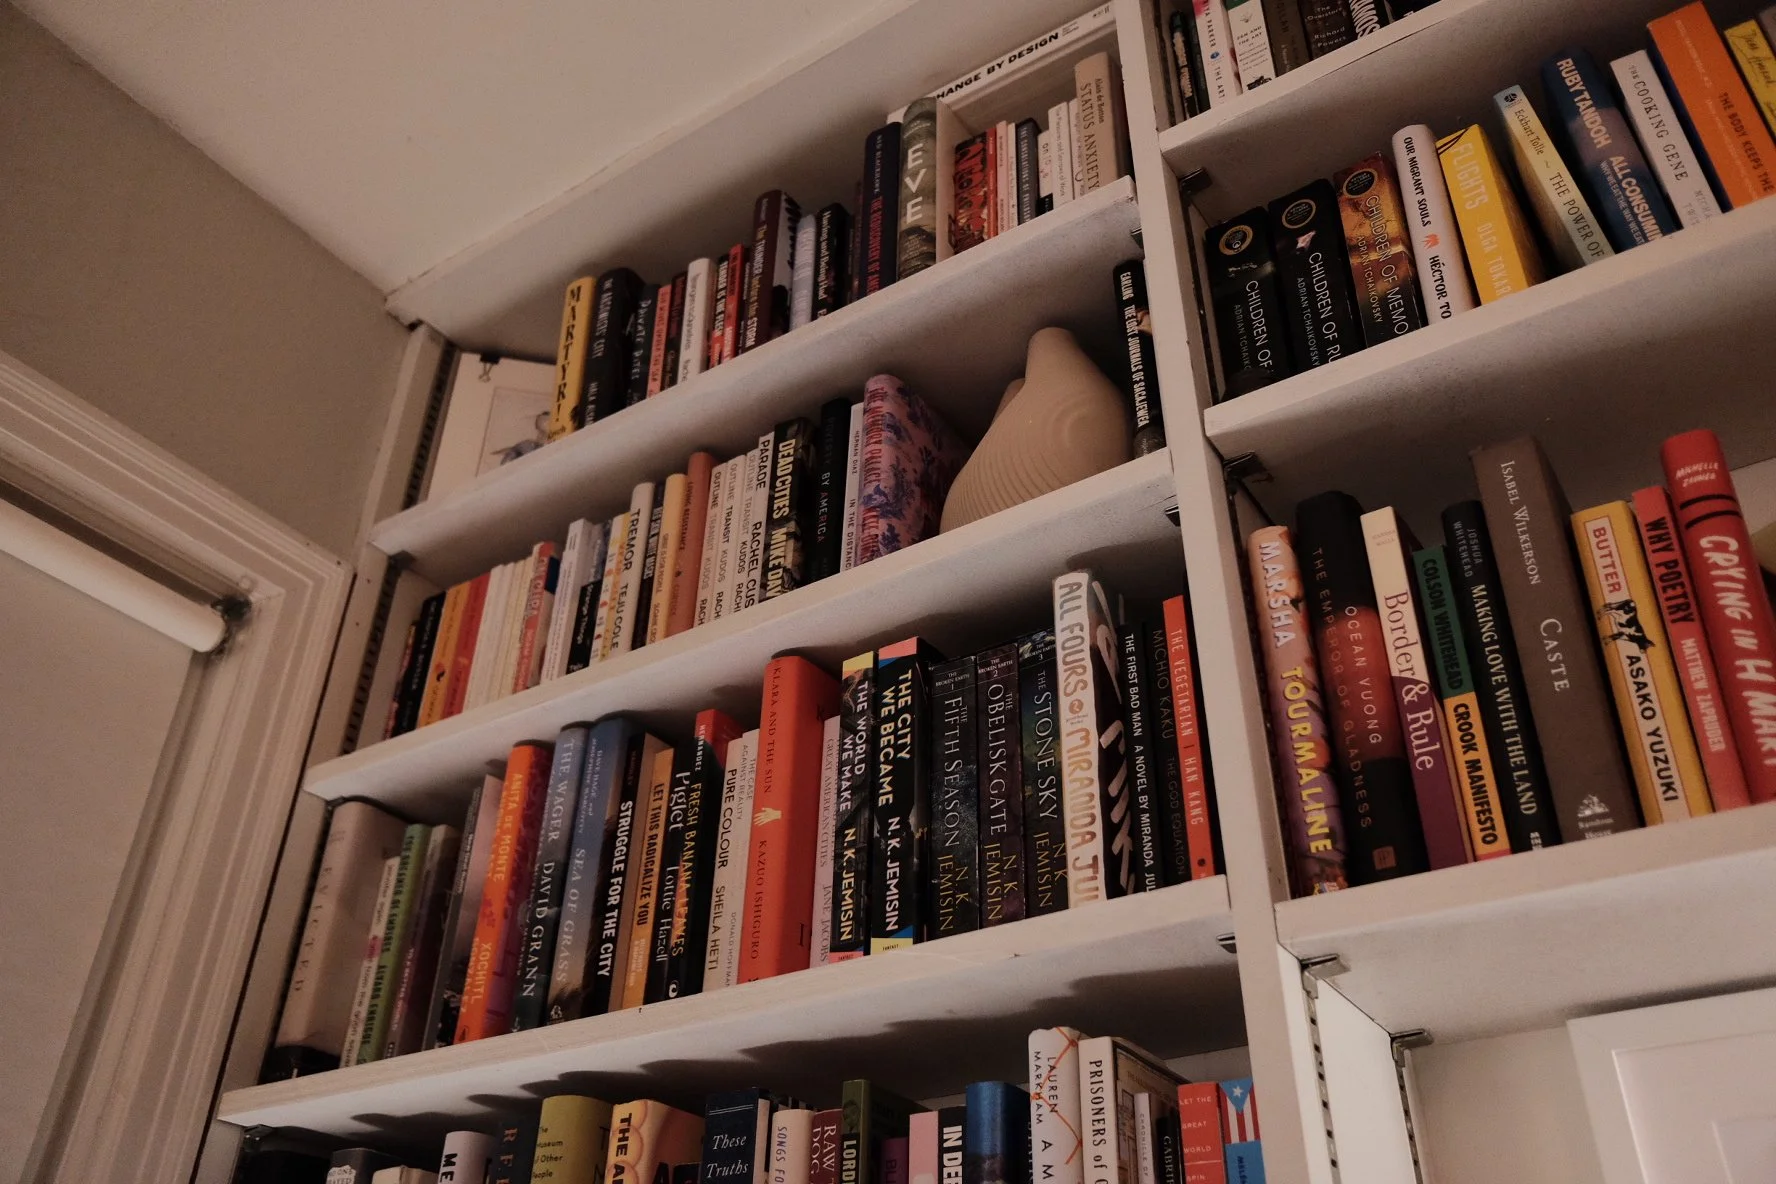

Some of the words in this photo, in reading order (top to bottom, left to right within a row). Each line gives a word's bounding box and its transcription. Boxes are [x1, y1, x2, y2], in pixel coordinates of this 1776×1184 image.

[1307, 7, 1344, 20] Overstory
[1314, 26, 1345, 40] Richard
[1317, 36, 1347, 47] Powers
[937, 73, 981, 99] HANGE
[987, 60, 1004, 75] BY
[1008, 32, 1059, 63] DESIGN
[1080, 83, 1094, 130] STATUS
[1556, 58, 1583, 93] RUBY
[1575, 93, 1612, 149] TANDOH
[1628, 65, 1639, 79] THE
[1634, 80, 1669, 138] COOKING
[1662, 144, 1688, 182] GENE
[1403, 137, 1416, 155] OUR
[1514, 108, 1536, 136] Eckhart
[1528, 136, 1545, 155] Tolle
[1718, 93, 1734, 111] THE
[1729, 113, 1748, 137] BODY
[1742, 141, 1763, 170] KEEPS
[1758, 171, 1775, 193] THE
[1084, 134, 1100, 190] ANXIETY
[1408, 156, 1424, 195] MIGRANT
[1451, 143, 1488, 210] FLIGHTS
[1365, 196, 1392, 262] CHILDREN
[1418, 199, 1431, 227] SOULS
[1548, 172, 1569, 197] THE
[1566, 199, 1594, 239] POWER
[1586, 241, 1604, 257] OF
[1120, 271, 1134, 300] EARLING
[1297, 277, 1308, 307] ADRIAN
[1309, 252, 1333, 318] CHILDREN
[1322, 322, 1338, 341] OF
[1357, 237, 1369, 265] ADRIAN
[1363, 268, 1383, 323] TCHAIKOVSKY
[1382, 264, 1397, 283] OF
[1123, 304, 1136, 319] THE
[1126, 320, 1139, 336] LOST
[1246, 280, 1268, 346] CHILDREN
[1258, 350, 1273, 368] OF
[1386, 288, 1409, 334] MEMO
[1128, 337, 1143, 371] JOURNALS
[1302, 309, 1320, 366] TCHAIKOVSKY
[1133, 372, 1144, 381] OF
[1134, 381, 1149, 428] SACAJEWEA
[756, 440, 770, 491] PARADE
[776, 439, 795, 479] DEAD
[1676, 462, 1719, 480] MICHELLE
[1682, 472, 1717, 488] ZAUNER
[727, 464, 738, 502] OUTLINE
[772, 477, 791, 520] CITIES
[623, 509, 640, 571] TREMOR
[722, 506, 733, 544] TRANSIT
[1644, 516, 1672, 555] WHY
[718, 549, 728, 582] KUDOS
[748, 521, 762, 577] RACHEL
[1592, 527, 1622, 595] BUTTER
[616, 583, 629, 613] TEJU
[715, 591, 724, 619] RACH
[745, 579, 756, 609] CUS
[1058, 582, 1085, 620] ALL
[1259, 541, 1296, 648] MARSHA
[1469, 584, 1497, 642] MAKING
[1655, 560, 1695, 625] POETRY
[610, 616, 622, 651] COLE
[1124, 634, 1136, 654] THE
[1383, 592, 1419, 680] Border
[1421, 559, 1446, 610] COLSON
[1434, 613, 1462, 690] WHITEHEAD
[935, 678, 954, 686] BROKEN
[955, 673, 970, 681] EARTH
[978, 664, 997, 673] BROKEN
[998, 660, 1013, 669] EARTH
[1061, 624, 1088, 697] FOURS
[1126, 656, 1139, 684] FIRST
[1344, 605, 1366, 667] OCEAN
[1358, 677, 1383, 744] VUONG
[1482, 645, 1507, 684] LOVE
[856, 681, 868, 713] THE
[880, 685, 895, 718] WE
[898, 670, 912, 709] THE
[1129, 687, 1141, 709] BAD
[1152, 631, 1169, 689] MICHIO
[1161, 697, 1174, 739] KAKU
[1402, 683, 1430, 705] &
[944, 697, 962, 754] FIFTH
[987, 684, 1007, 776] OBELISK
[1131, 713, 1143, 737] MAN
[1452, 702, 1480, 755] CROOK
[1494, 687, 1519, 733] WITH
[1625, 655, 1657, 721] ASAKO
[1644, 727, 1679, 803] YUZUKI
[558, 739, 575, 776] THE
[854, 716, 867, 776] WORLD
[897, 716, 911, 760] CITY
[1281, 667, 1333, 855] TOURMALINE
[1405, 711, 1437, 771] Rule
[1504, 733, 1527, 767] THE
[723, 769, 738, 804] PURE
[878, 723, 894, 807] BECAME
[1166, 756, 1177, 777] THE
[1184, 757, 1198, 782] HAN
[546, 780, 569, 843] WAGER
[651, 783, 664, 802] LET
[668, 771, 691, 832] Piglet
[685, 783, 702, 825] FRESH
[944, 760, 962, 847] SEASON
[989, 779, 1006, 836] GATE
[1167, 780, 1180, 808] GOD
[1188, 791, 1203, 825] KANG
[1465, 759, 1498, 845] MANIFESTO
[1512, 770, 1538, 815] LAND
[610, 800, 633, 873] STRUGGLE
[647, 806, 661, 831] THIS
[718, 807, 733, 869] COLOUR
[639, 834, 658, 900] RADICALIZE
[677, 830, 697, 891] BANANA
[756, 840, 768, 887] KAZUO
[1171, 813, 1186, 875] EQUATION
[535, 862, 556, 918] DAVID
[606, 877, 623, 905] FOR
[661, 865, 679, 911] Lottie
[984, 842, 1002, 920] JEMISIN
[1033, 831, 1052, 908] JEMISIN
[636, 902, 652, 926] YOU
[937, 854, 953, 932] JEMISIN
[602, 909, 620, 939] THE
[655, 918, 675, 962] Hazell
[671, 898, 689, 957] LEAVES
[749, 891, 764, 960] ISHIGURO
[471, 942, 492, 1004] XOCHITL
[522, 925, 545, 996] GRANN
[596, 942, 614, 977] CITY
[1032, 1051, 1044, 1125] MARKHAM
[1047, 1056, 1059, 1113] LAUREN
[1090, 1060, 1106, 1146] PRISONERS
[615, 1112, 633, 1157] THE
[713, 1134, 747, 1151] These
[823, 1123, 837, 1172] RAW
[1182, 1121, 1206, 1129] GREAT
[707, 1160, 749, 1179] Truths
[1093, 1155, 1107, 1169] of
